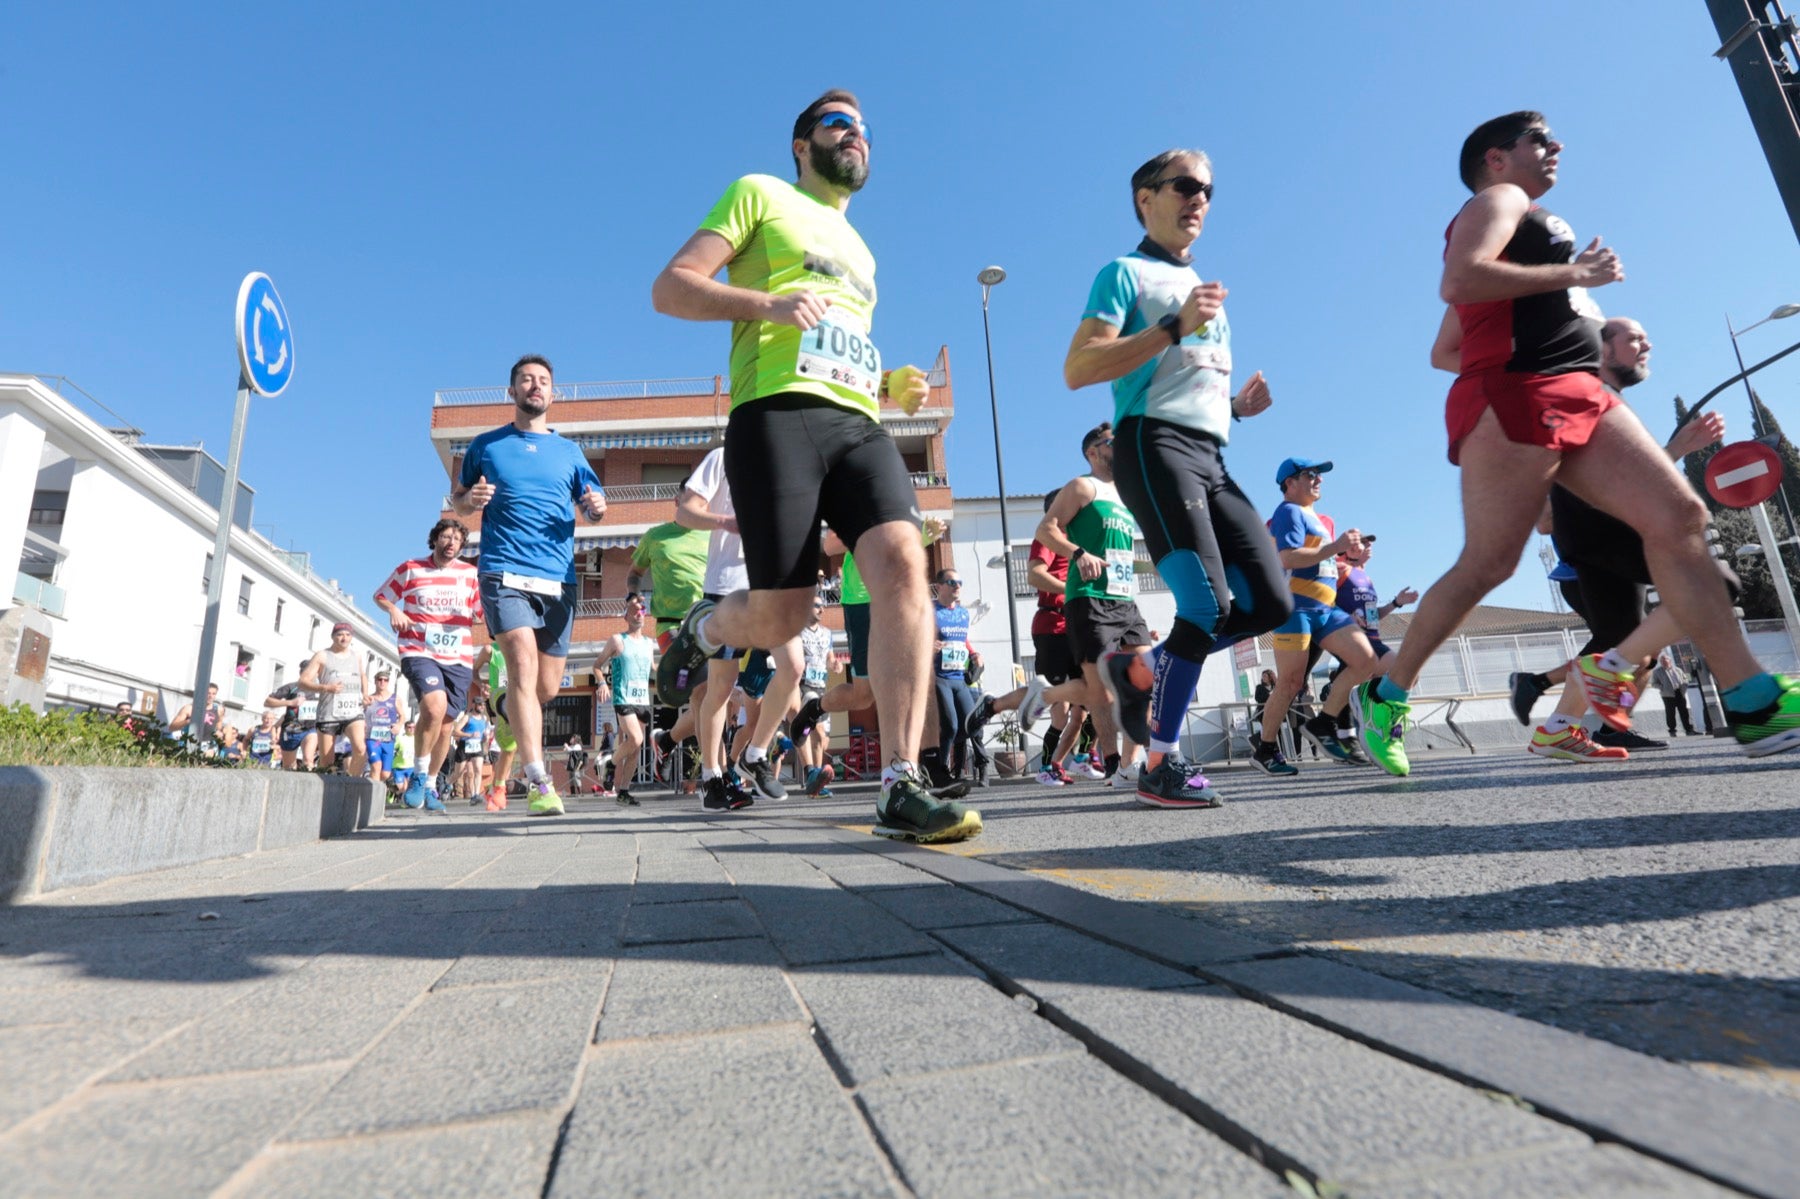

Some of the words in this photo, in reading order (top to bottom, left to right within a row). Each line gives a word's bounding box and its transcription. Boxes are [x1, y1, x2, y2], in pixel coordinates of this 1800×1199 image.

[811, 325, 877, 373] 1093
[417, 595, 464, 607] Cazorla
[432, 633, 458, 647] 367
[948, 650, 966, 661] 479
[631, 688, 646, 697] 837
